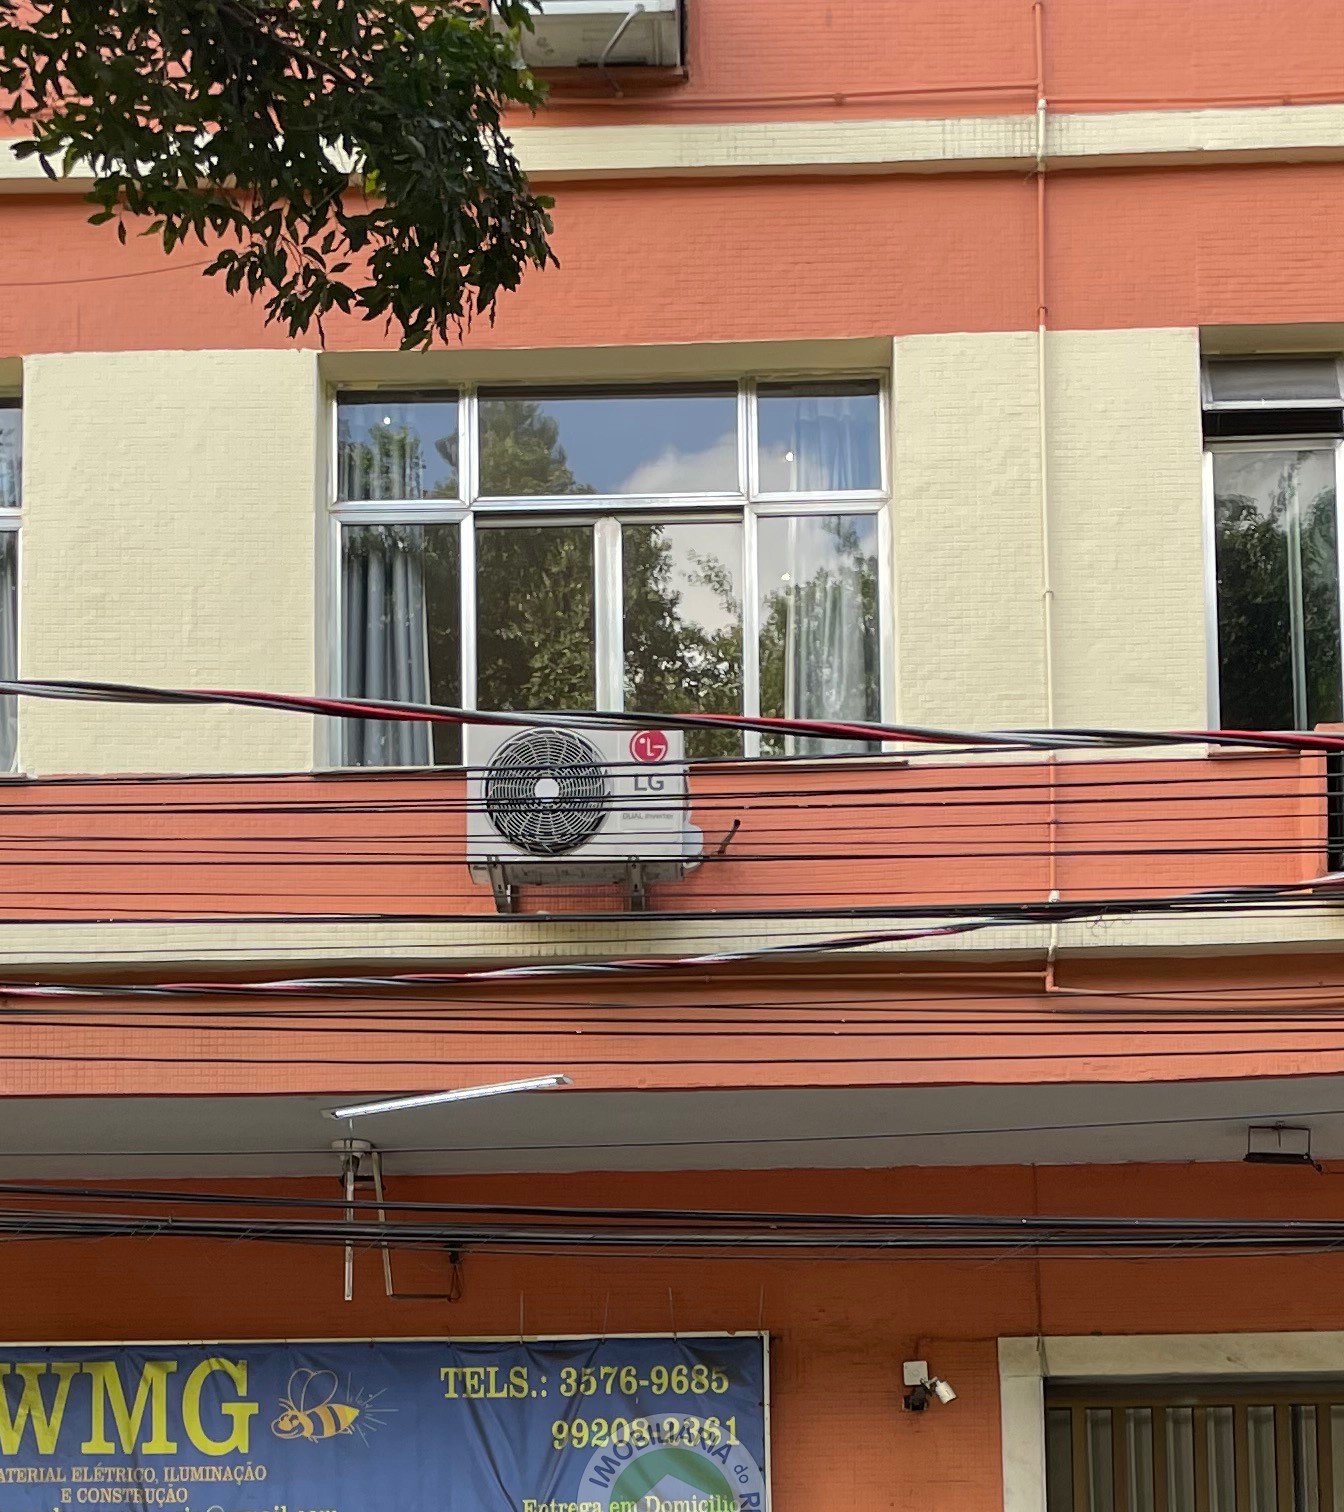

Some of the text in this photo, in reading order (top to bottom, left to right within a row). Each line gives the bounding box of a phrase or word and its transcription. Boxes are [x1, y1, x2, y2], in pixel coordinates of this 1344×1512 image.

[634, 774, 664, 791] LG
[440, 1363, 729, 1398] TELS.: 3576-9685
[71, 1462, 159, 1485] ELÉTRICO,
[164, 1465, 267, 1486] ILUMINAÇÃO
[61, 1484, 188, 1505] E CONSTRUÇÃO
